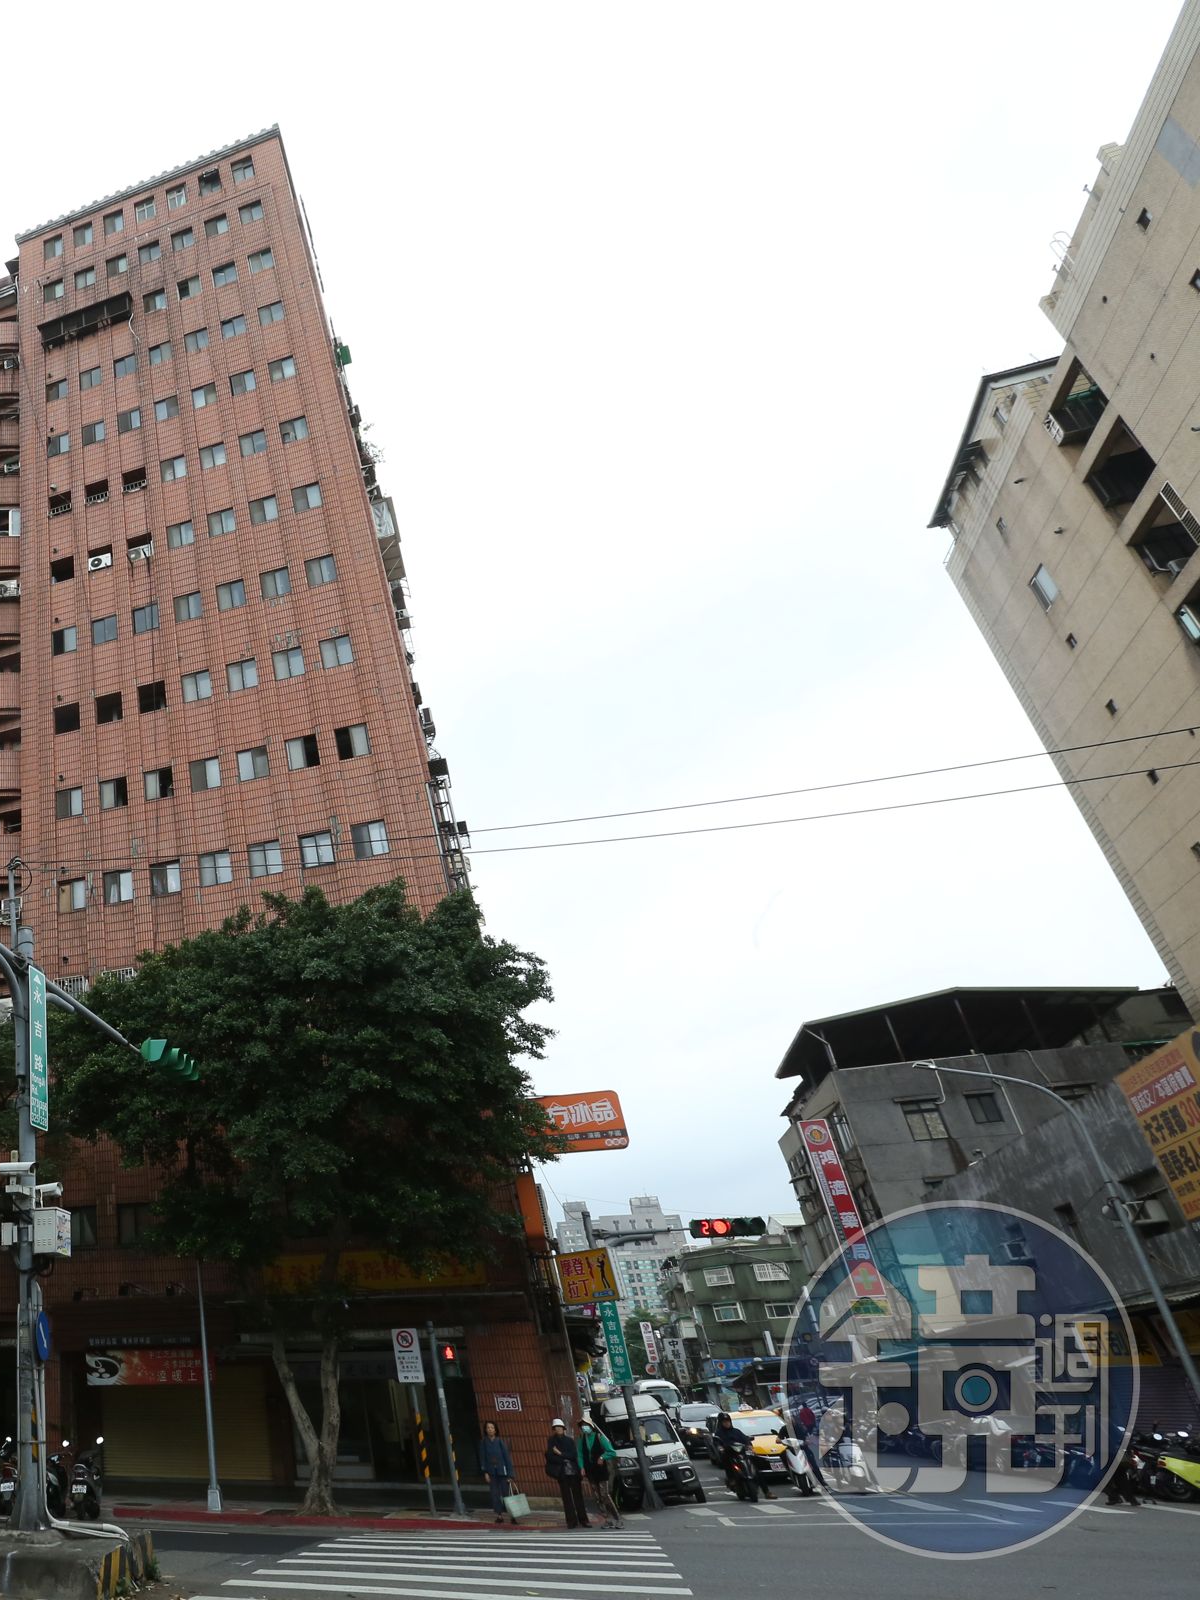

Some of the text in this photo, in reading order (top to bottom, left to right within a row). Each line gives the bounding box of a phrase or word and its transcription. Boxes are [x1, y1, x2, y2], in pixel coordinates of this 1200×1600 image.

[32, 986, 45, 1073] 永吉路
[499, 1400, 518, 1410] 328
